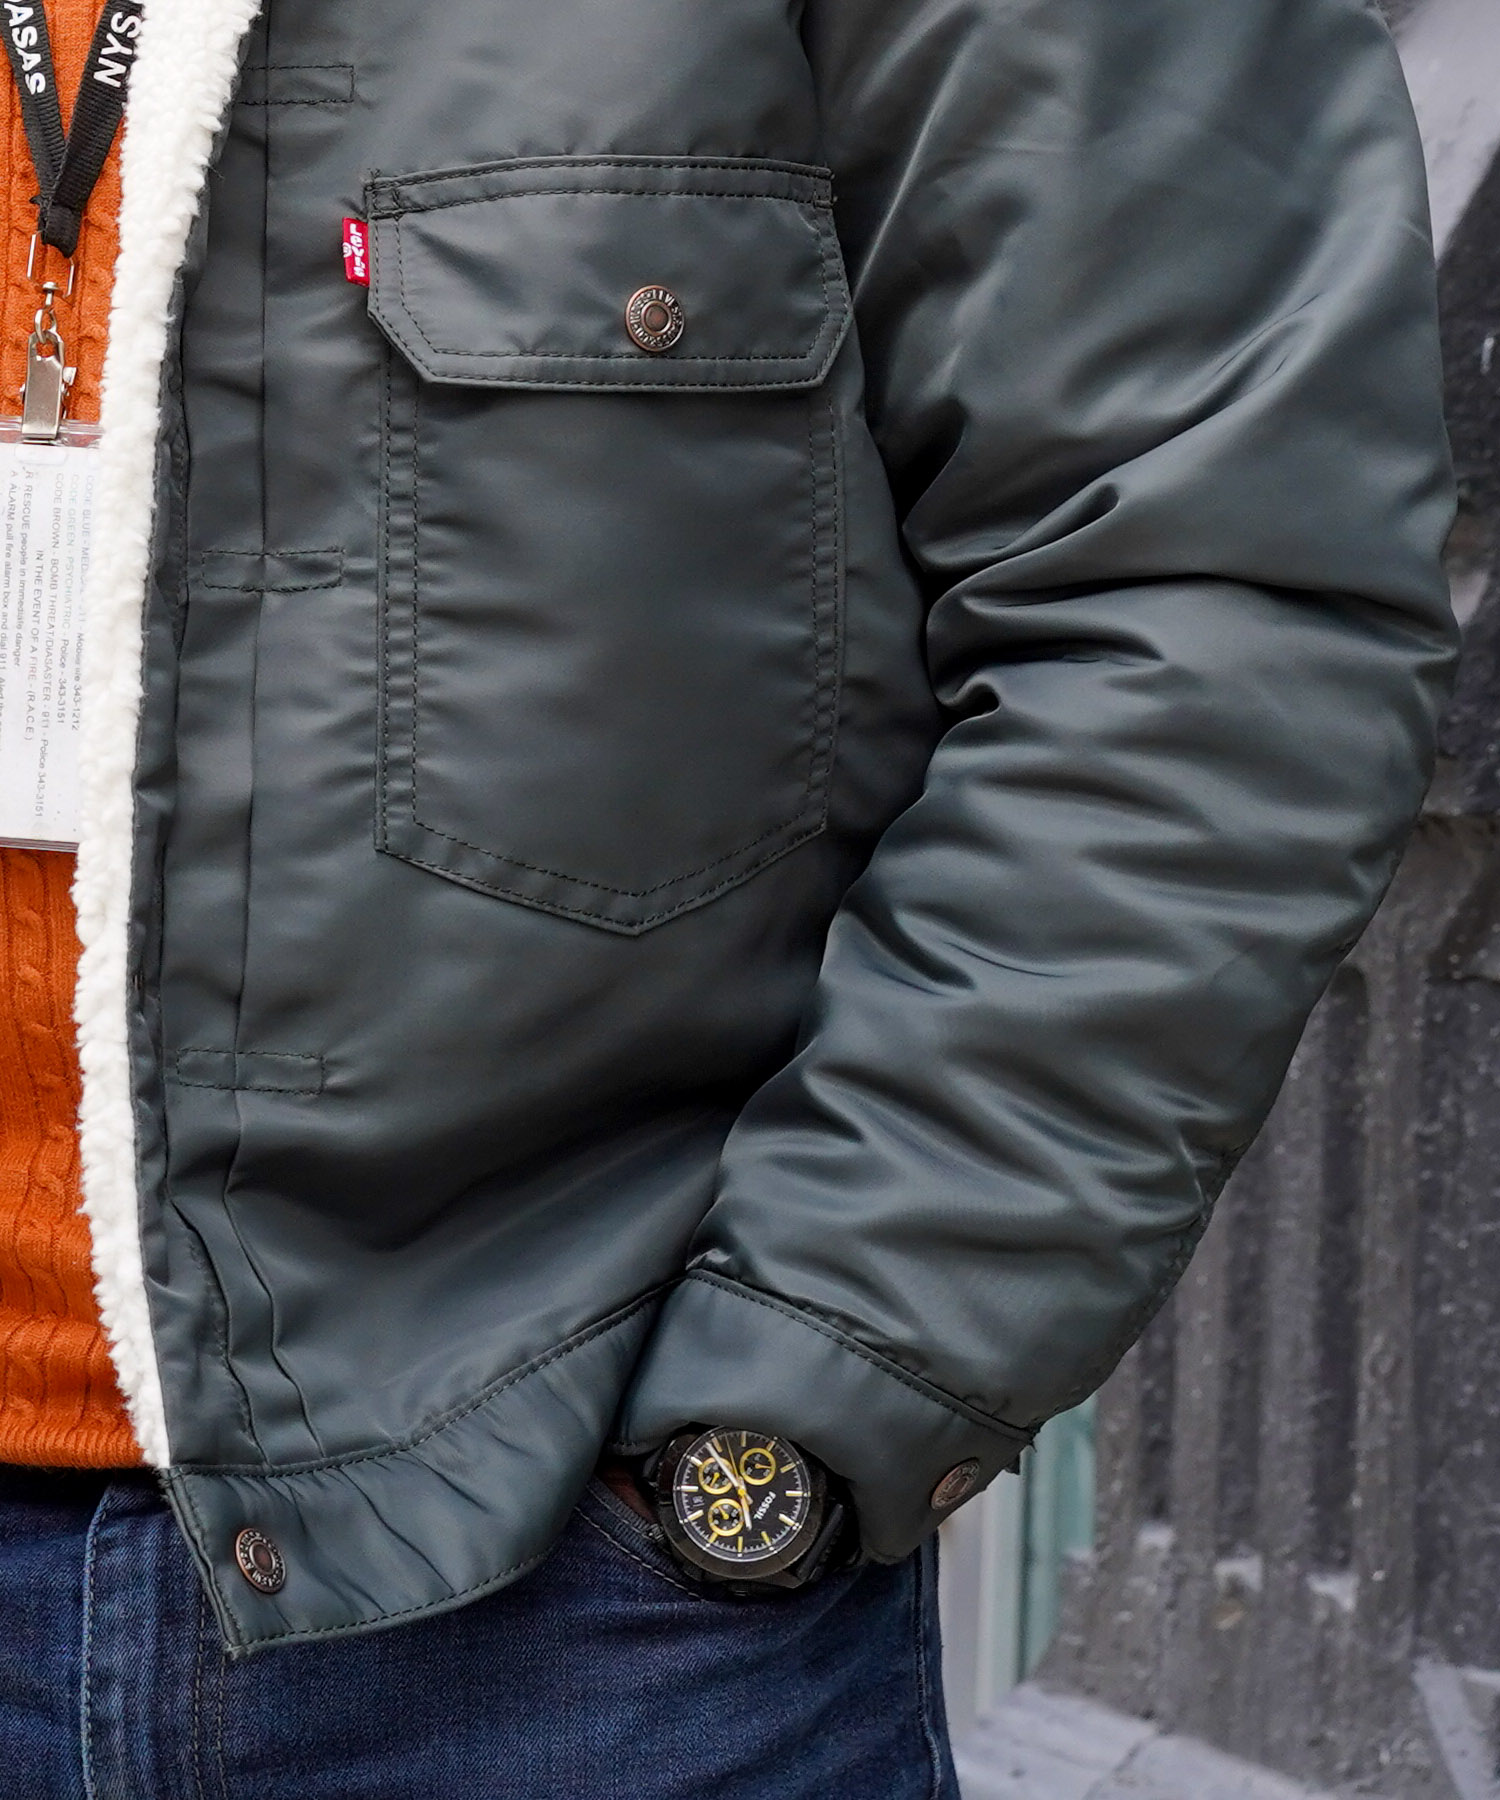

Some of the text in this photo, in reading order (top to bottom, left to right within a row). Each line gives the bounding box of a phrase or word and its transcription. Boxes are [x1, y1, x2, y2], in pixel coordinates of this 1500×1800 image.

[93, 11, 142, 89] NYS
[7, 483, 17, 520] ALARM
[53, 473, 64, 504] CODE
[68, 474, 80, 505] CODE
[83, 475, 95, 506] CODE
[21, 484, 33, 529] RESCUE
[5, 523, 14, 540] pull
[51, 507, 61, 548] BROWN
[66, 508, 76, 547] GREEN
[82, 509, 91, 537] BLUE
[5, 543, 14, 558] fire
[19, 533, 28, 565] people
[35, 550, 44, 561] IN
[3, 561, 12, 588] alarm
[19, 568, 28, 577] in
[34, 564, 44, 585] THE
[49, 558, 59, 590] BOMB
[2, 591, 11, 609] box
[32, 589, 42, 624] EVENT
[0, 612, 9, 630] and
[30, 628, 40, 643] OF
[0, 632, 8, 650] dial
[12, 632, 23, 667] danger
[59, 639, 69, 669] Police
[27, 656, 38, 680] FIRE
[57, 678, 67, 723] 343-3151
[72, 685, 82, 730] 343-1212
[41, 711, 50, 728] 911
[39, 739, 49, 769] Police
[35, 772, 46, 816] 343-3151
[753, 1491, 776, 1520] FOSSIL
